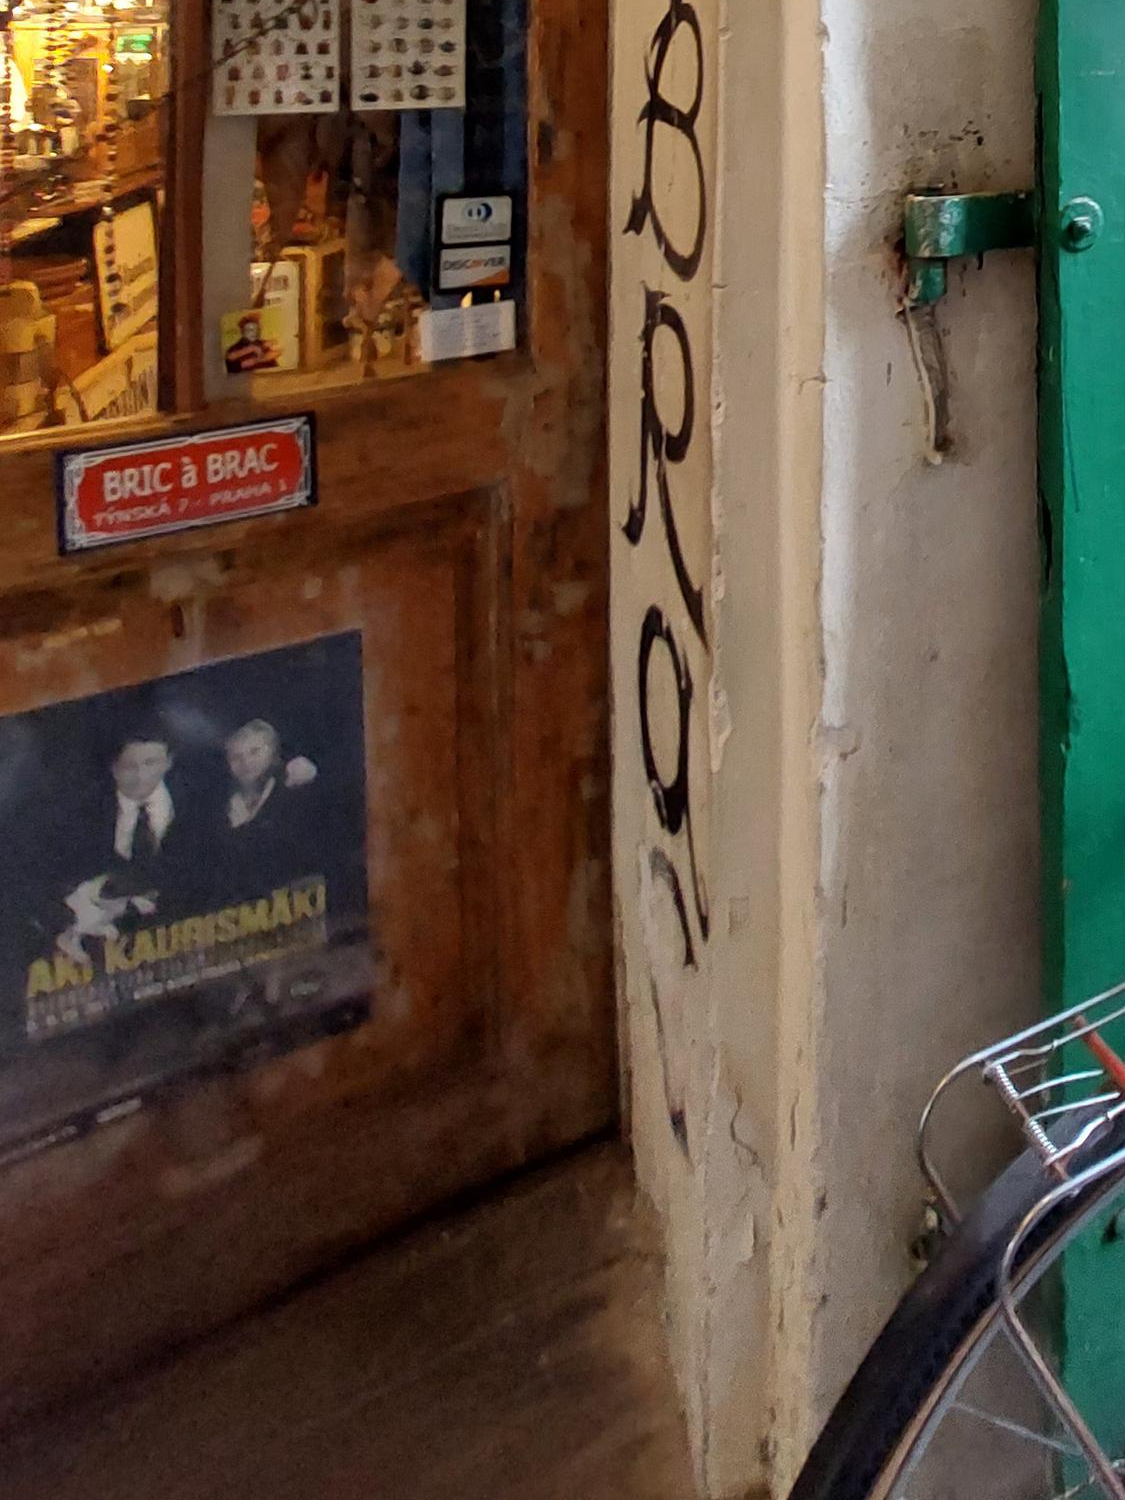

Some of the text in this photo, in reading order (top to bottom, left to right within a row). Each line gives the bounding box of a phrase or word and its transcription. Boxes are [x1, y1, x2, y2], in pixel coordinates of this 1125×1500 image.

[103, 442, 279, 501] BRIC à BRAC
